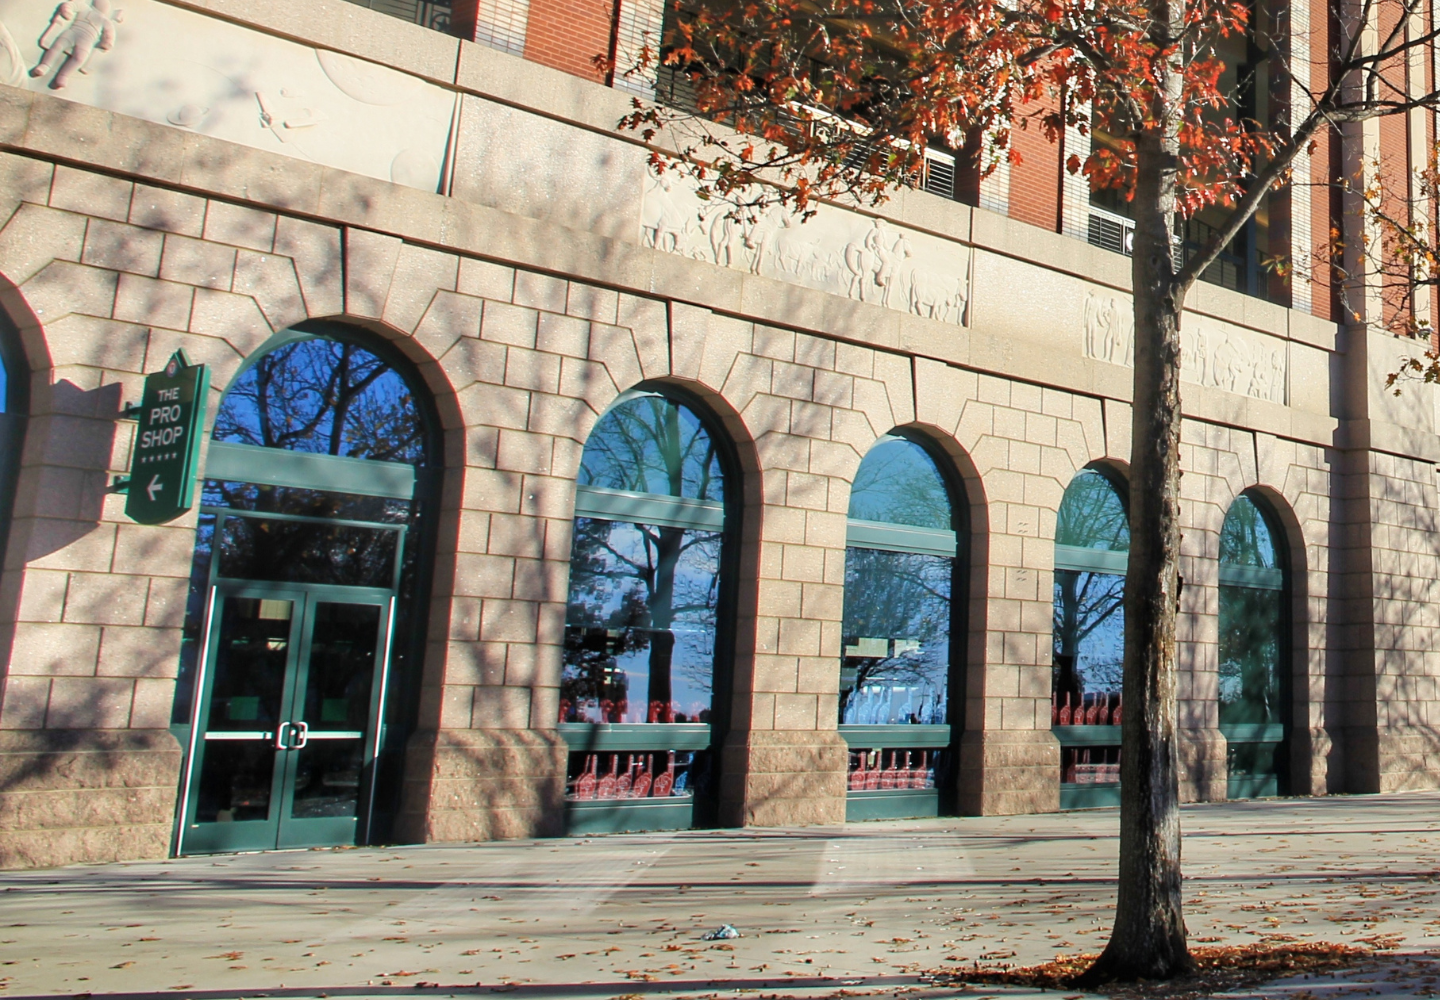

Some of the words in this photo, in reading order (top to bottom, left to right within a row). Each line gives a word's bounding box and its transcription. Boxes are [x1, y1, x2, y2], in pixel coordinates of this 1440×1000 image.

[158, 387, 180, 402] THE
[150, 405, 182, 425] PRO
[141, 426, 183, 448] SHOP
